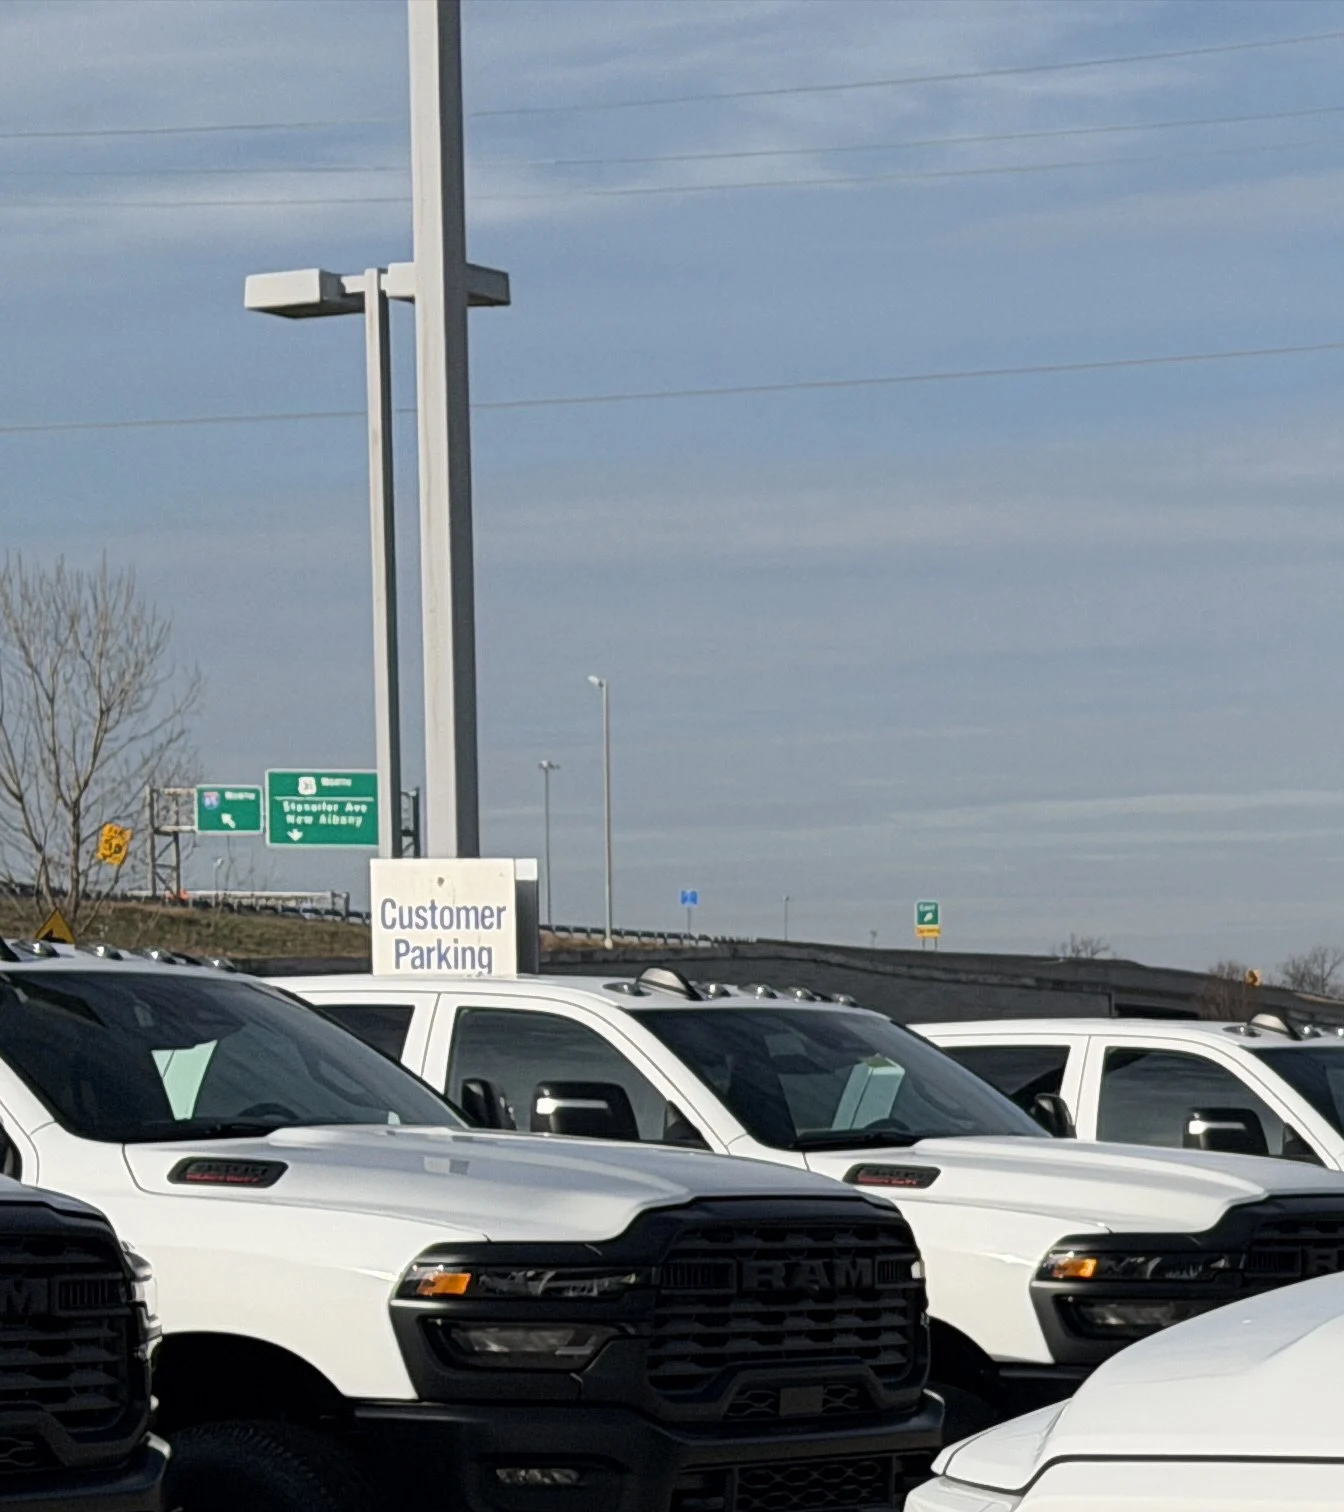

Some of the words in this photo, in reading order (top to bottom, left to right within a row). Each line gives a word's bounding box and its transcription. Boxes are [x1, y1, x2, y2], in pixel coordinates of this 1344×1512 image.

[286, 815, 313, 824] New
[380, 898, 506, 930] Customer
[394, 939, 492, 972] Parking
[743, 1258, 873, 1291] RAM
